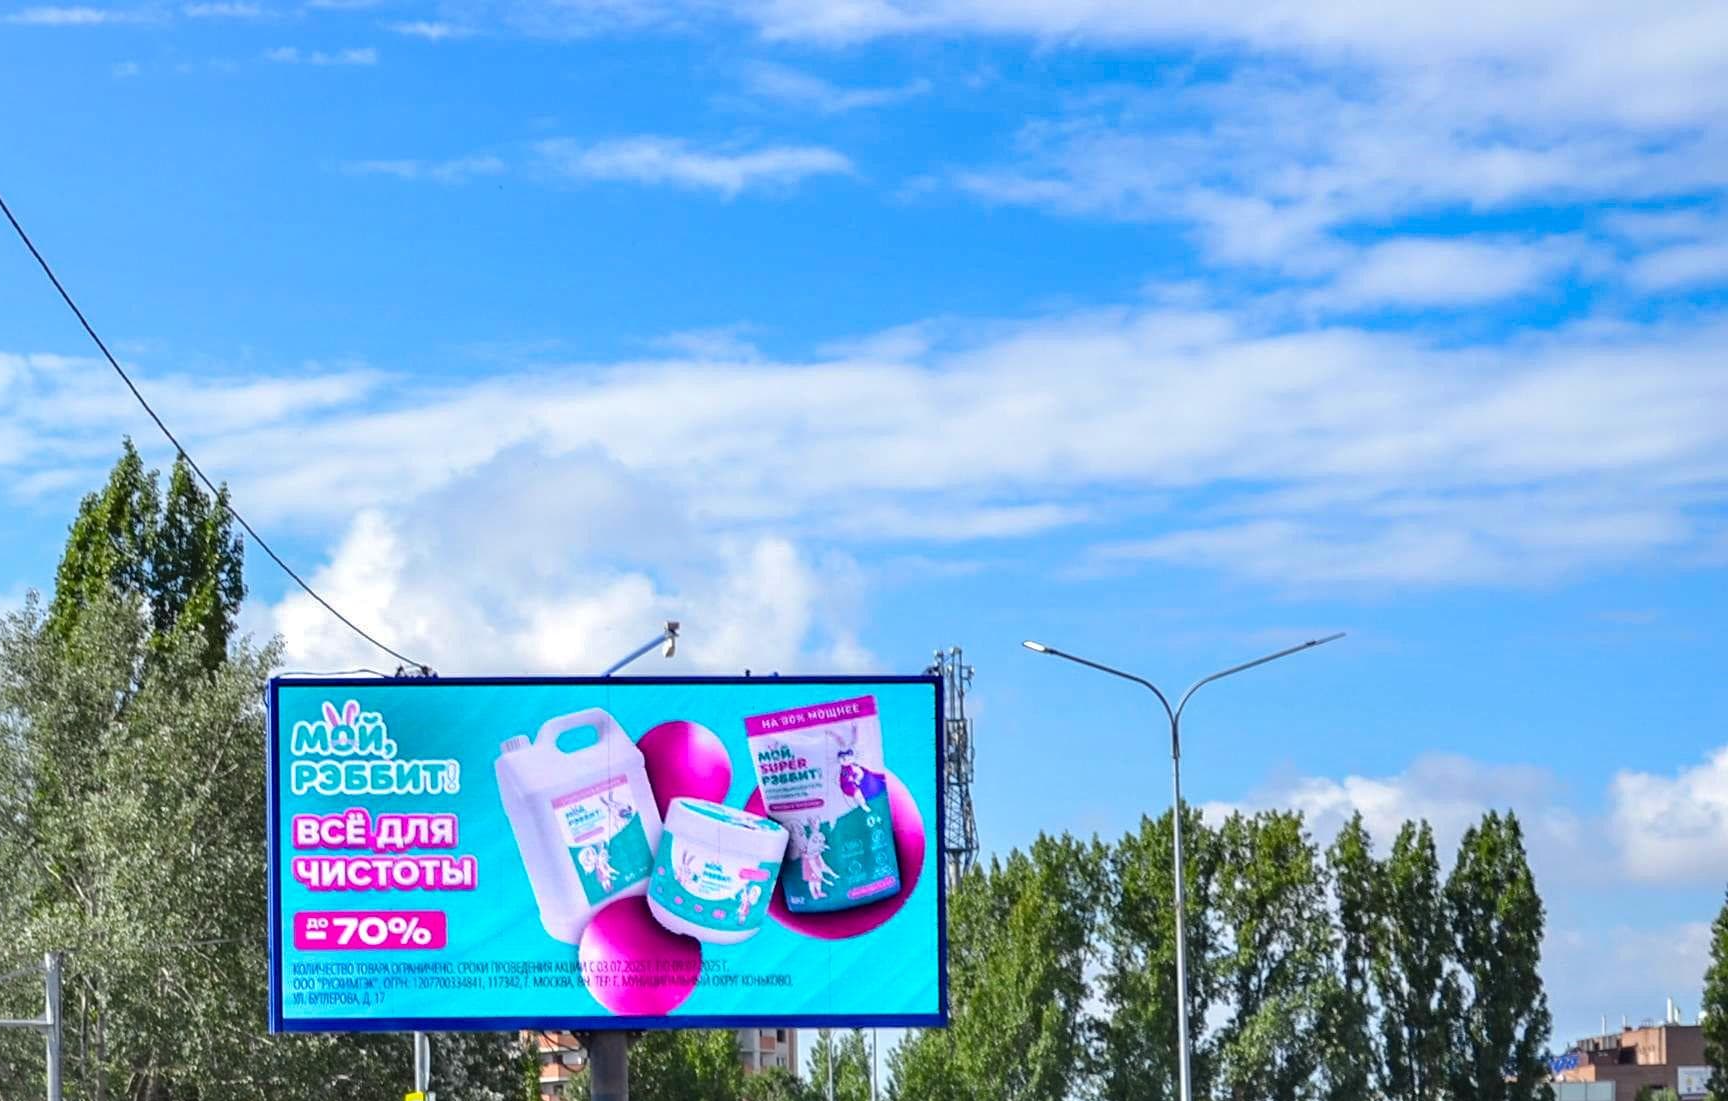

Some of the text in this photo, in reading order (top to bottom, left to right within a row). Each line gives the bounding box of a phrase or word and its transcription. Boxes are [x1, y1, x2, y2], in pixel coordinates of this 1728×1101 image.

[292, 712, 397, 759] МОЙ,
[292, 761, 459, 794] РЭББИТ!
[760, 758, 808, 774] SUPER
[295, 812, 454, 849] ВСЁ ДЛЯ
[295, 858, 474, 888] ЧИСТОТЫ
[293, 962, 355, 975] КОЛИЧЕСТВО
[357, 962, 390, 975] ТОВАРА
[457, 961, 488, 975] СРОКИ
[491, 961, 553, 975] ПРОВЕДЕНИЯ
[293, 977, 315, 990] ООО
[375, 992, 386, 1004] 17
